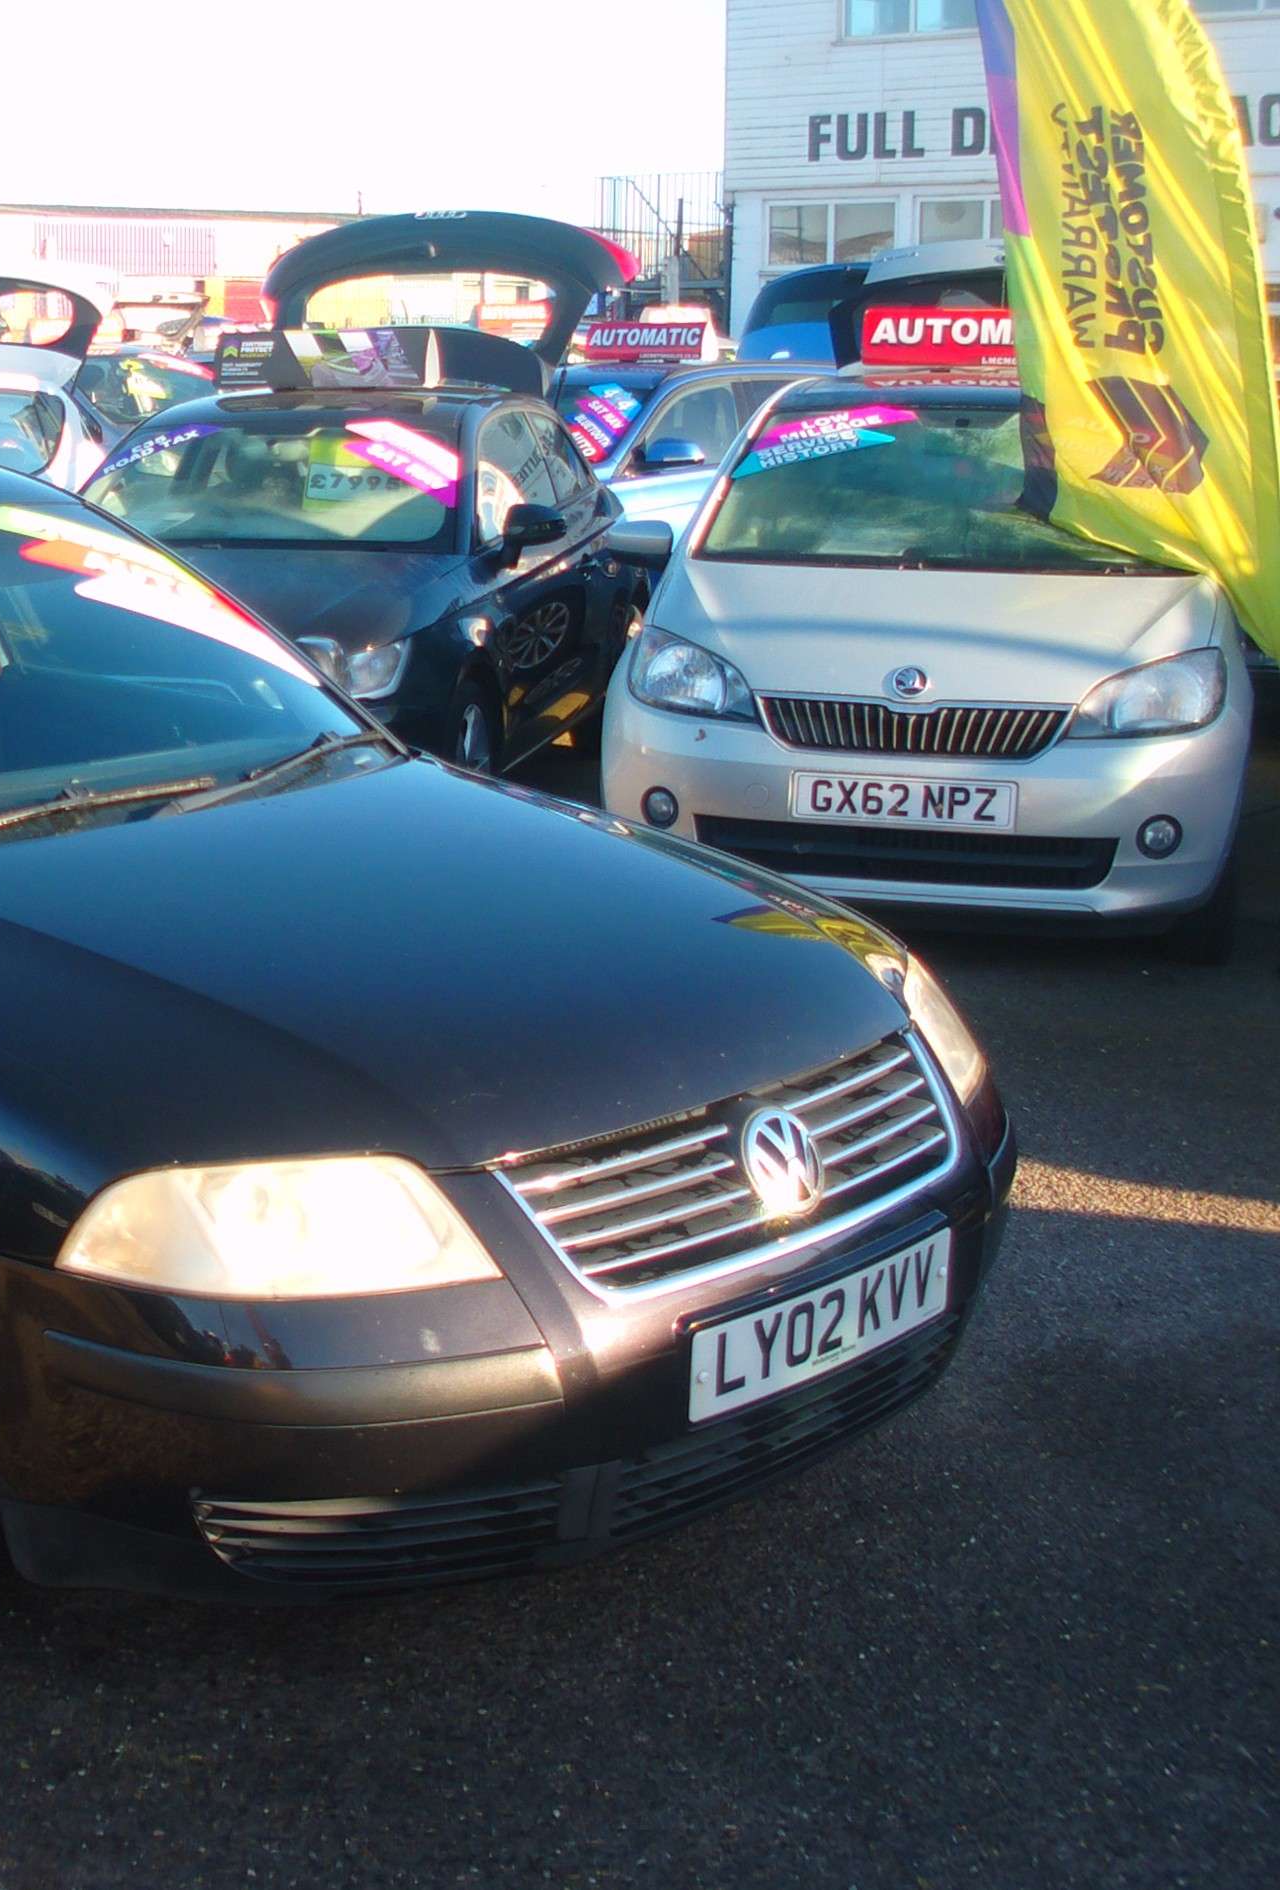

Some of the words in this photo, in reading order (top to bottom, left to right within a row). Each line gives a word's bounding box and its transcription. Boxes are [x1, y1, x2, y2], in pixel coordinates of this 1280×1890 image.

[808, 108, 925, 161] FULL
[951, 106, 996, 156] D
[590, 328, 702, 346] AUTOMATIC
[870, 317, 1015, 345] AUTOM
[588, 399, 606, 416] SAT
[800, 411, 851, 430] LOW
[758, 429, 858, 459] SERVICE
[779, 414, 883, 445] MILEAGE
[571, 431, 597, 458] AUTO
[759, 437, 862, 469] HISTORY
[810, 779, 910, 818] GX62
[921, 784, 998, 822] NPZ
